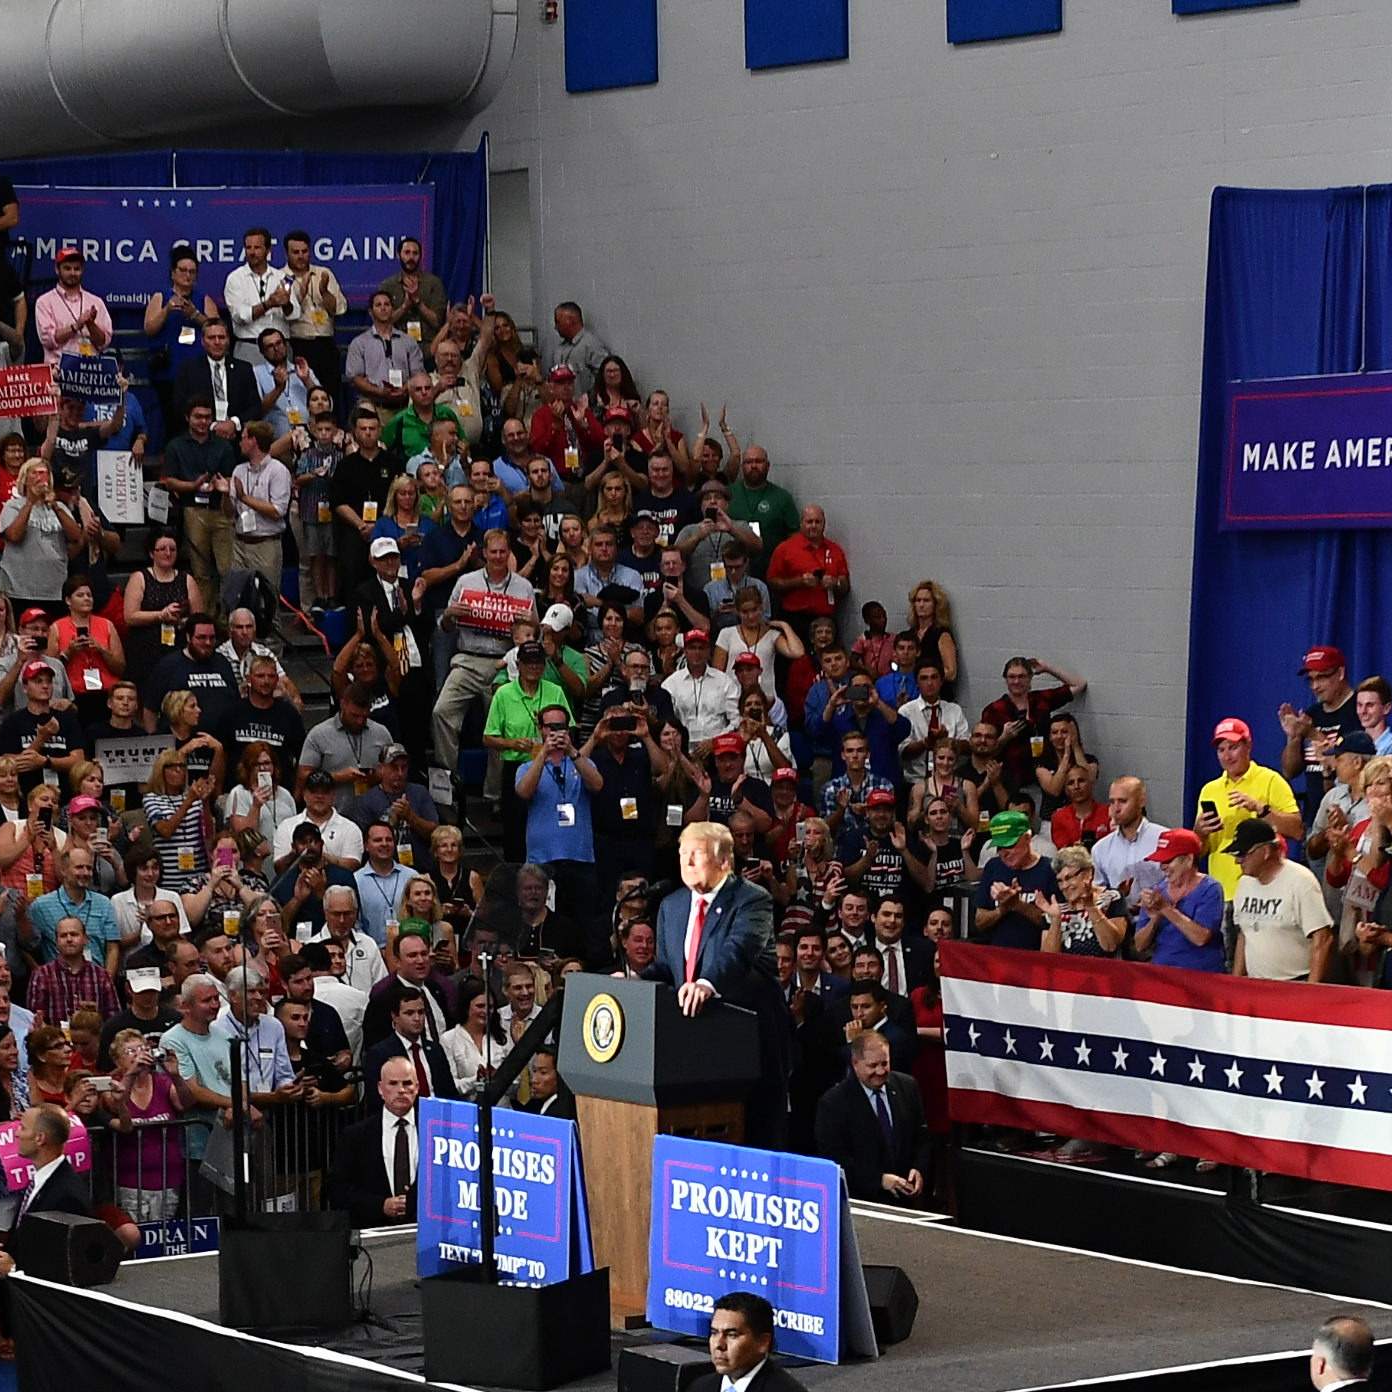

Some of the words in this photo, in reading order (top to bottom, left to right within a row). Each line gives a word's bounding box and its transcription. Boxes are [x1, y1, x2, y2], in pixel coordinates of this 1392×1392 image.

[6, 373, 31, 383] MAKE
[80, 363, 103, 372] MAKE
[21, 397, 54, 408] AGAIN
[95, 386, 120, 397] AGAIN
[1242, 440, 1315, 472] MAKE
[1241, 897, 1282, 915] ARMY
[457, 1187, 529, 1222] MDE
[671, 1178, 820, 1234] PROMISES
[439, 1241, 468, 1263] TEXT
[531, 1257, 545, 1279] TO
[706, 1224, 783, 1269] KEPT
[664, 1286, 714, 1313] 88022
